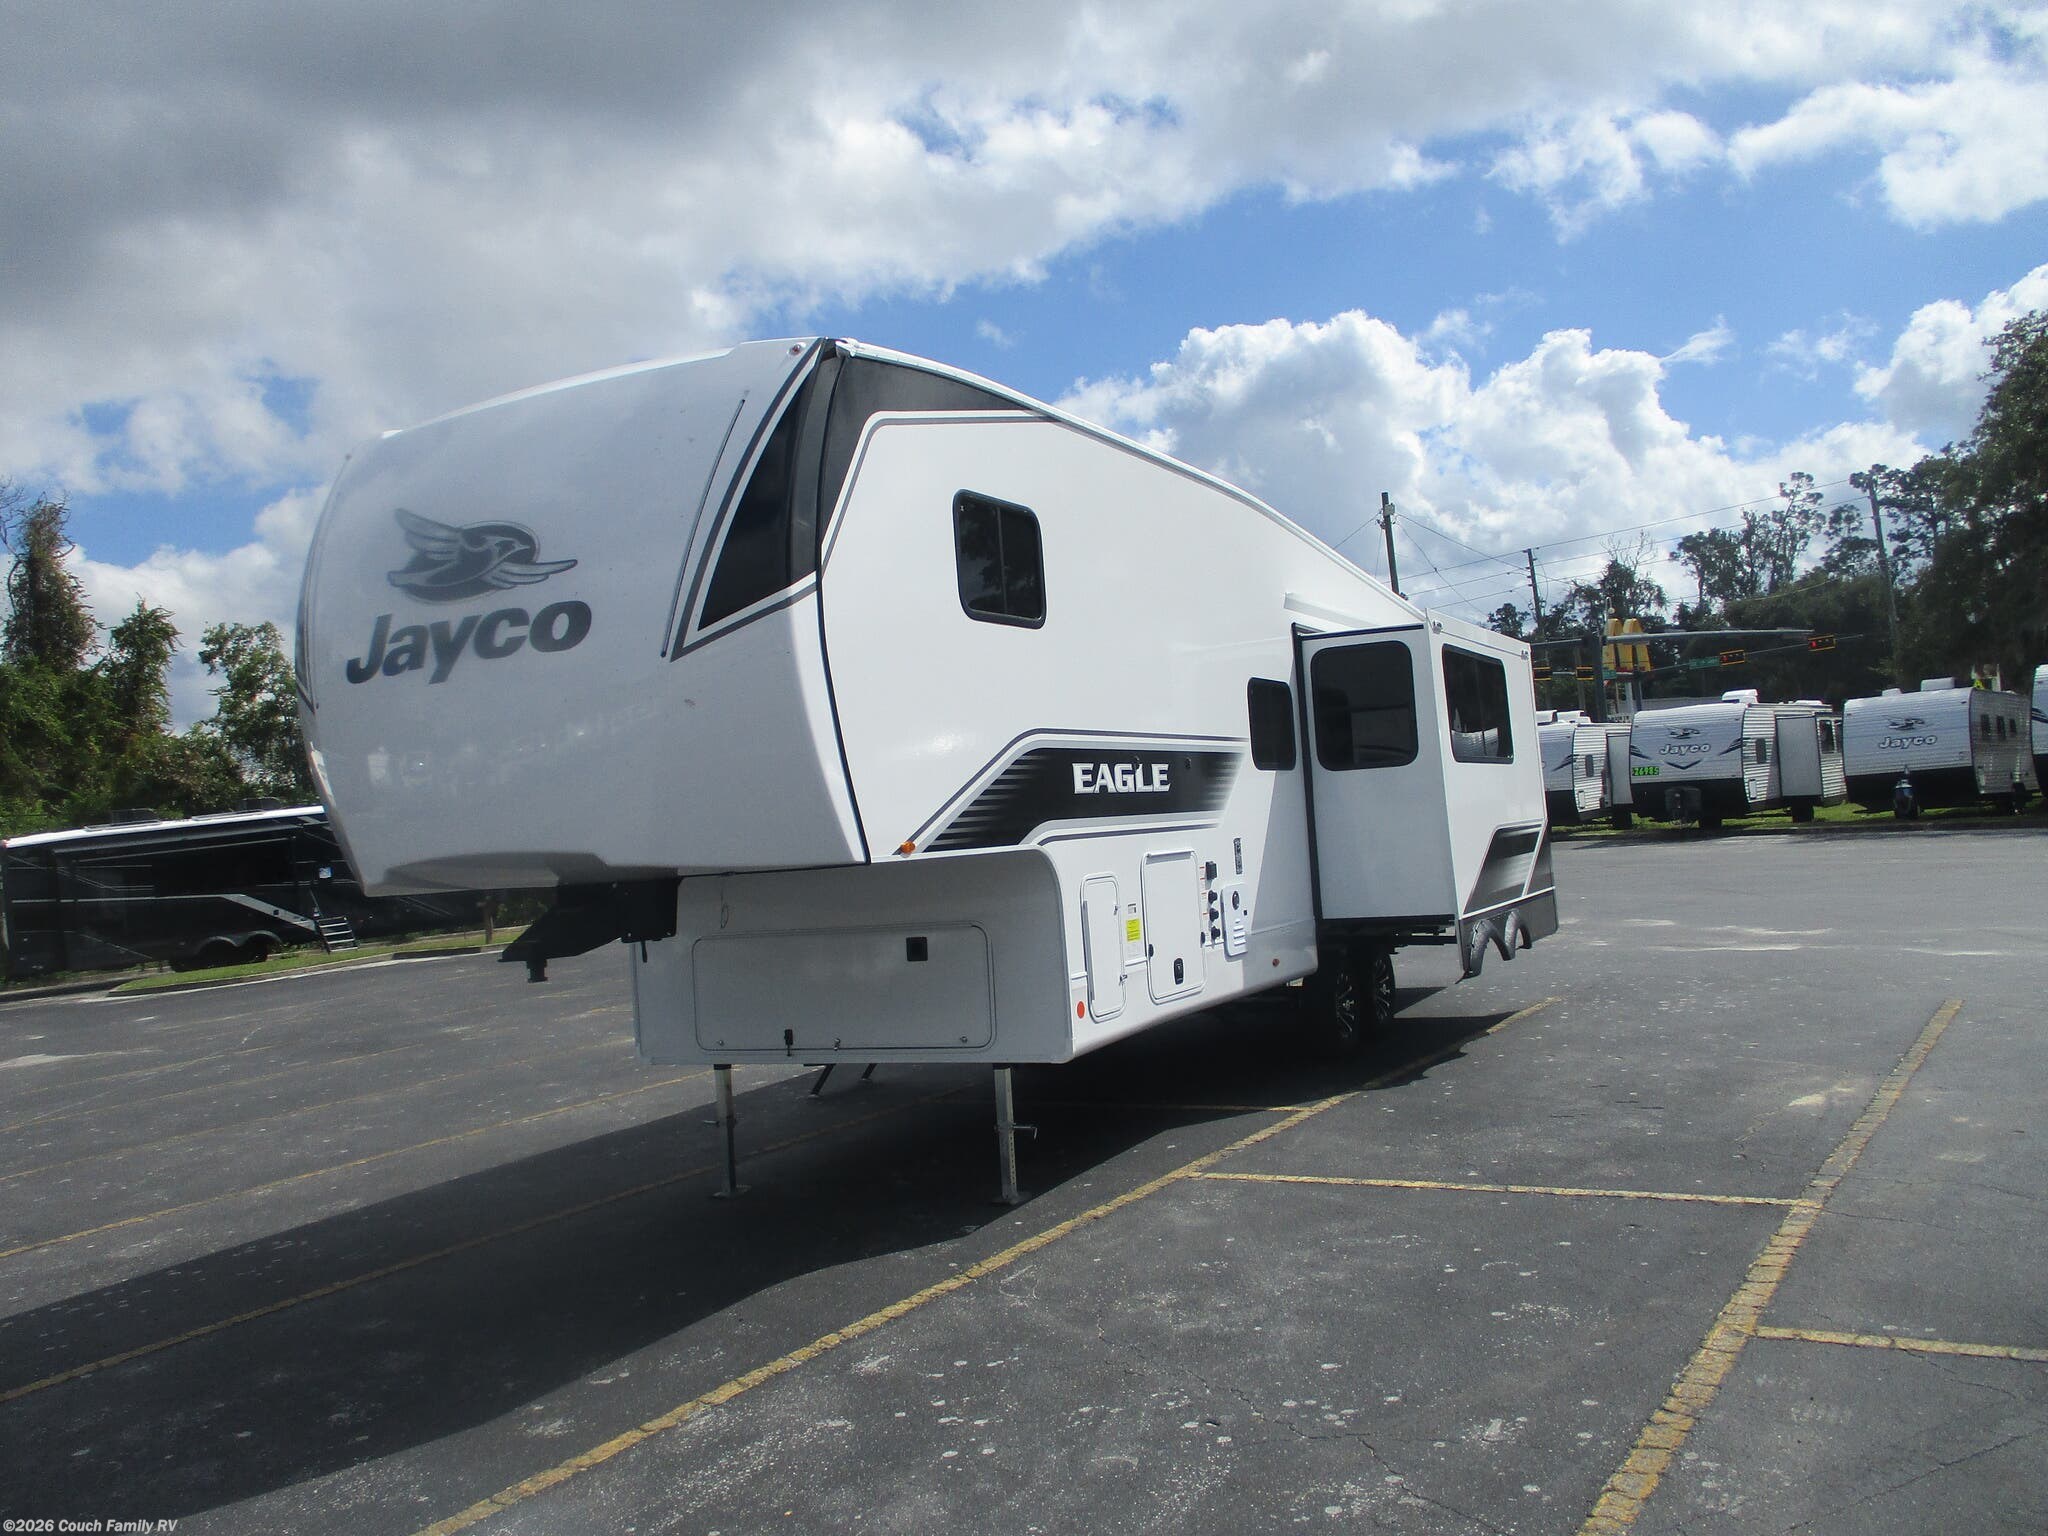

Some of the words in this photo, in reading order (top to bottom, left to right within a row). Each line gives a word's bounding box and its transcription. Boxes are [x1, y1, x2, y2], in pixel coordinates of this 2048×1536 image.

[346, 601, 592, 684] Jayco
[1659, 743, 1711, 756] Jayco
[1879, 735, 1937, 749] Jayco
[1072, 763, 1171, 794] EAGLE
